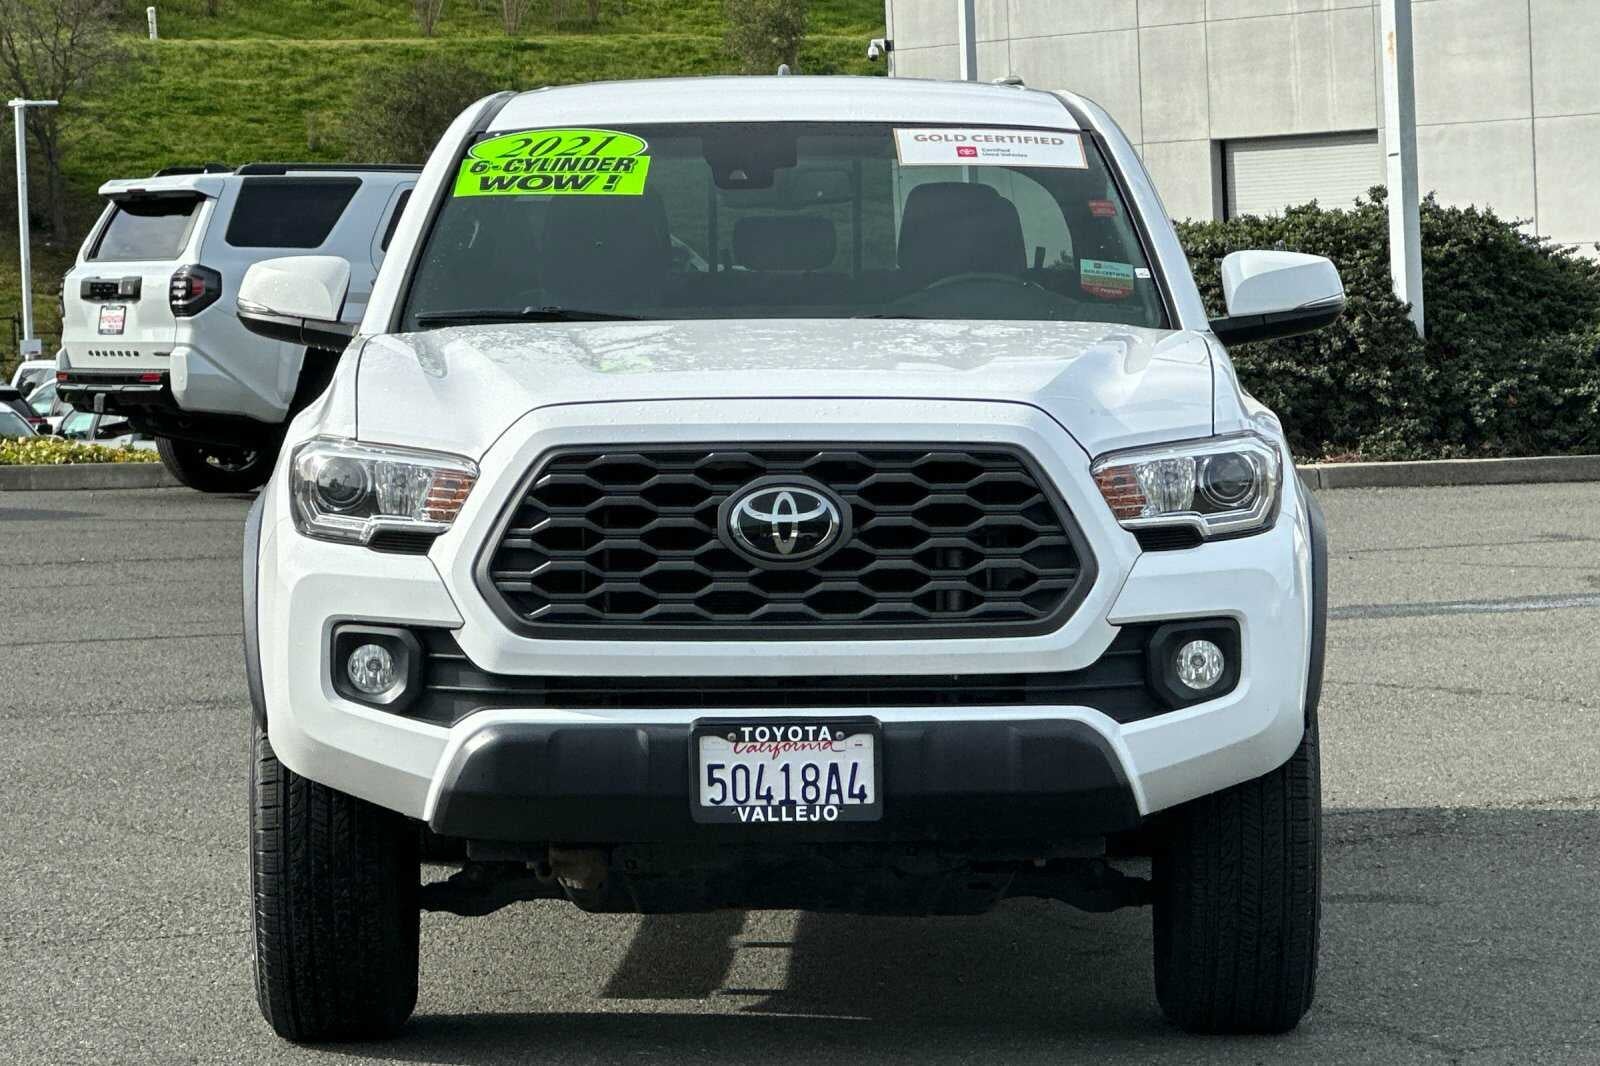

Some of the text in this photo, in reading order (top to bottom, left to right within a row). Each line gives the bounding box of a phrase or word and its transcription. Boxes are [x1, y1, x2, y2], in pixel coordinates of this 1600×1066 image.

[496, 135, 617, 158] 2021
[913, 134, 1065, 146] GOLD CERTIFIED
[470, 157, 636, 174] 6-CYLINDER
[479, 174, 598, 192] WOW
[740, 726, 832, 742] TOYOTA
[733, 740, 846, 760] California
[707, 762, 868, 806] 50418A4
[737, 805, 839, 822] VALLEJO
